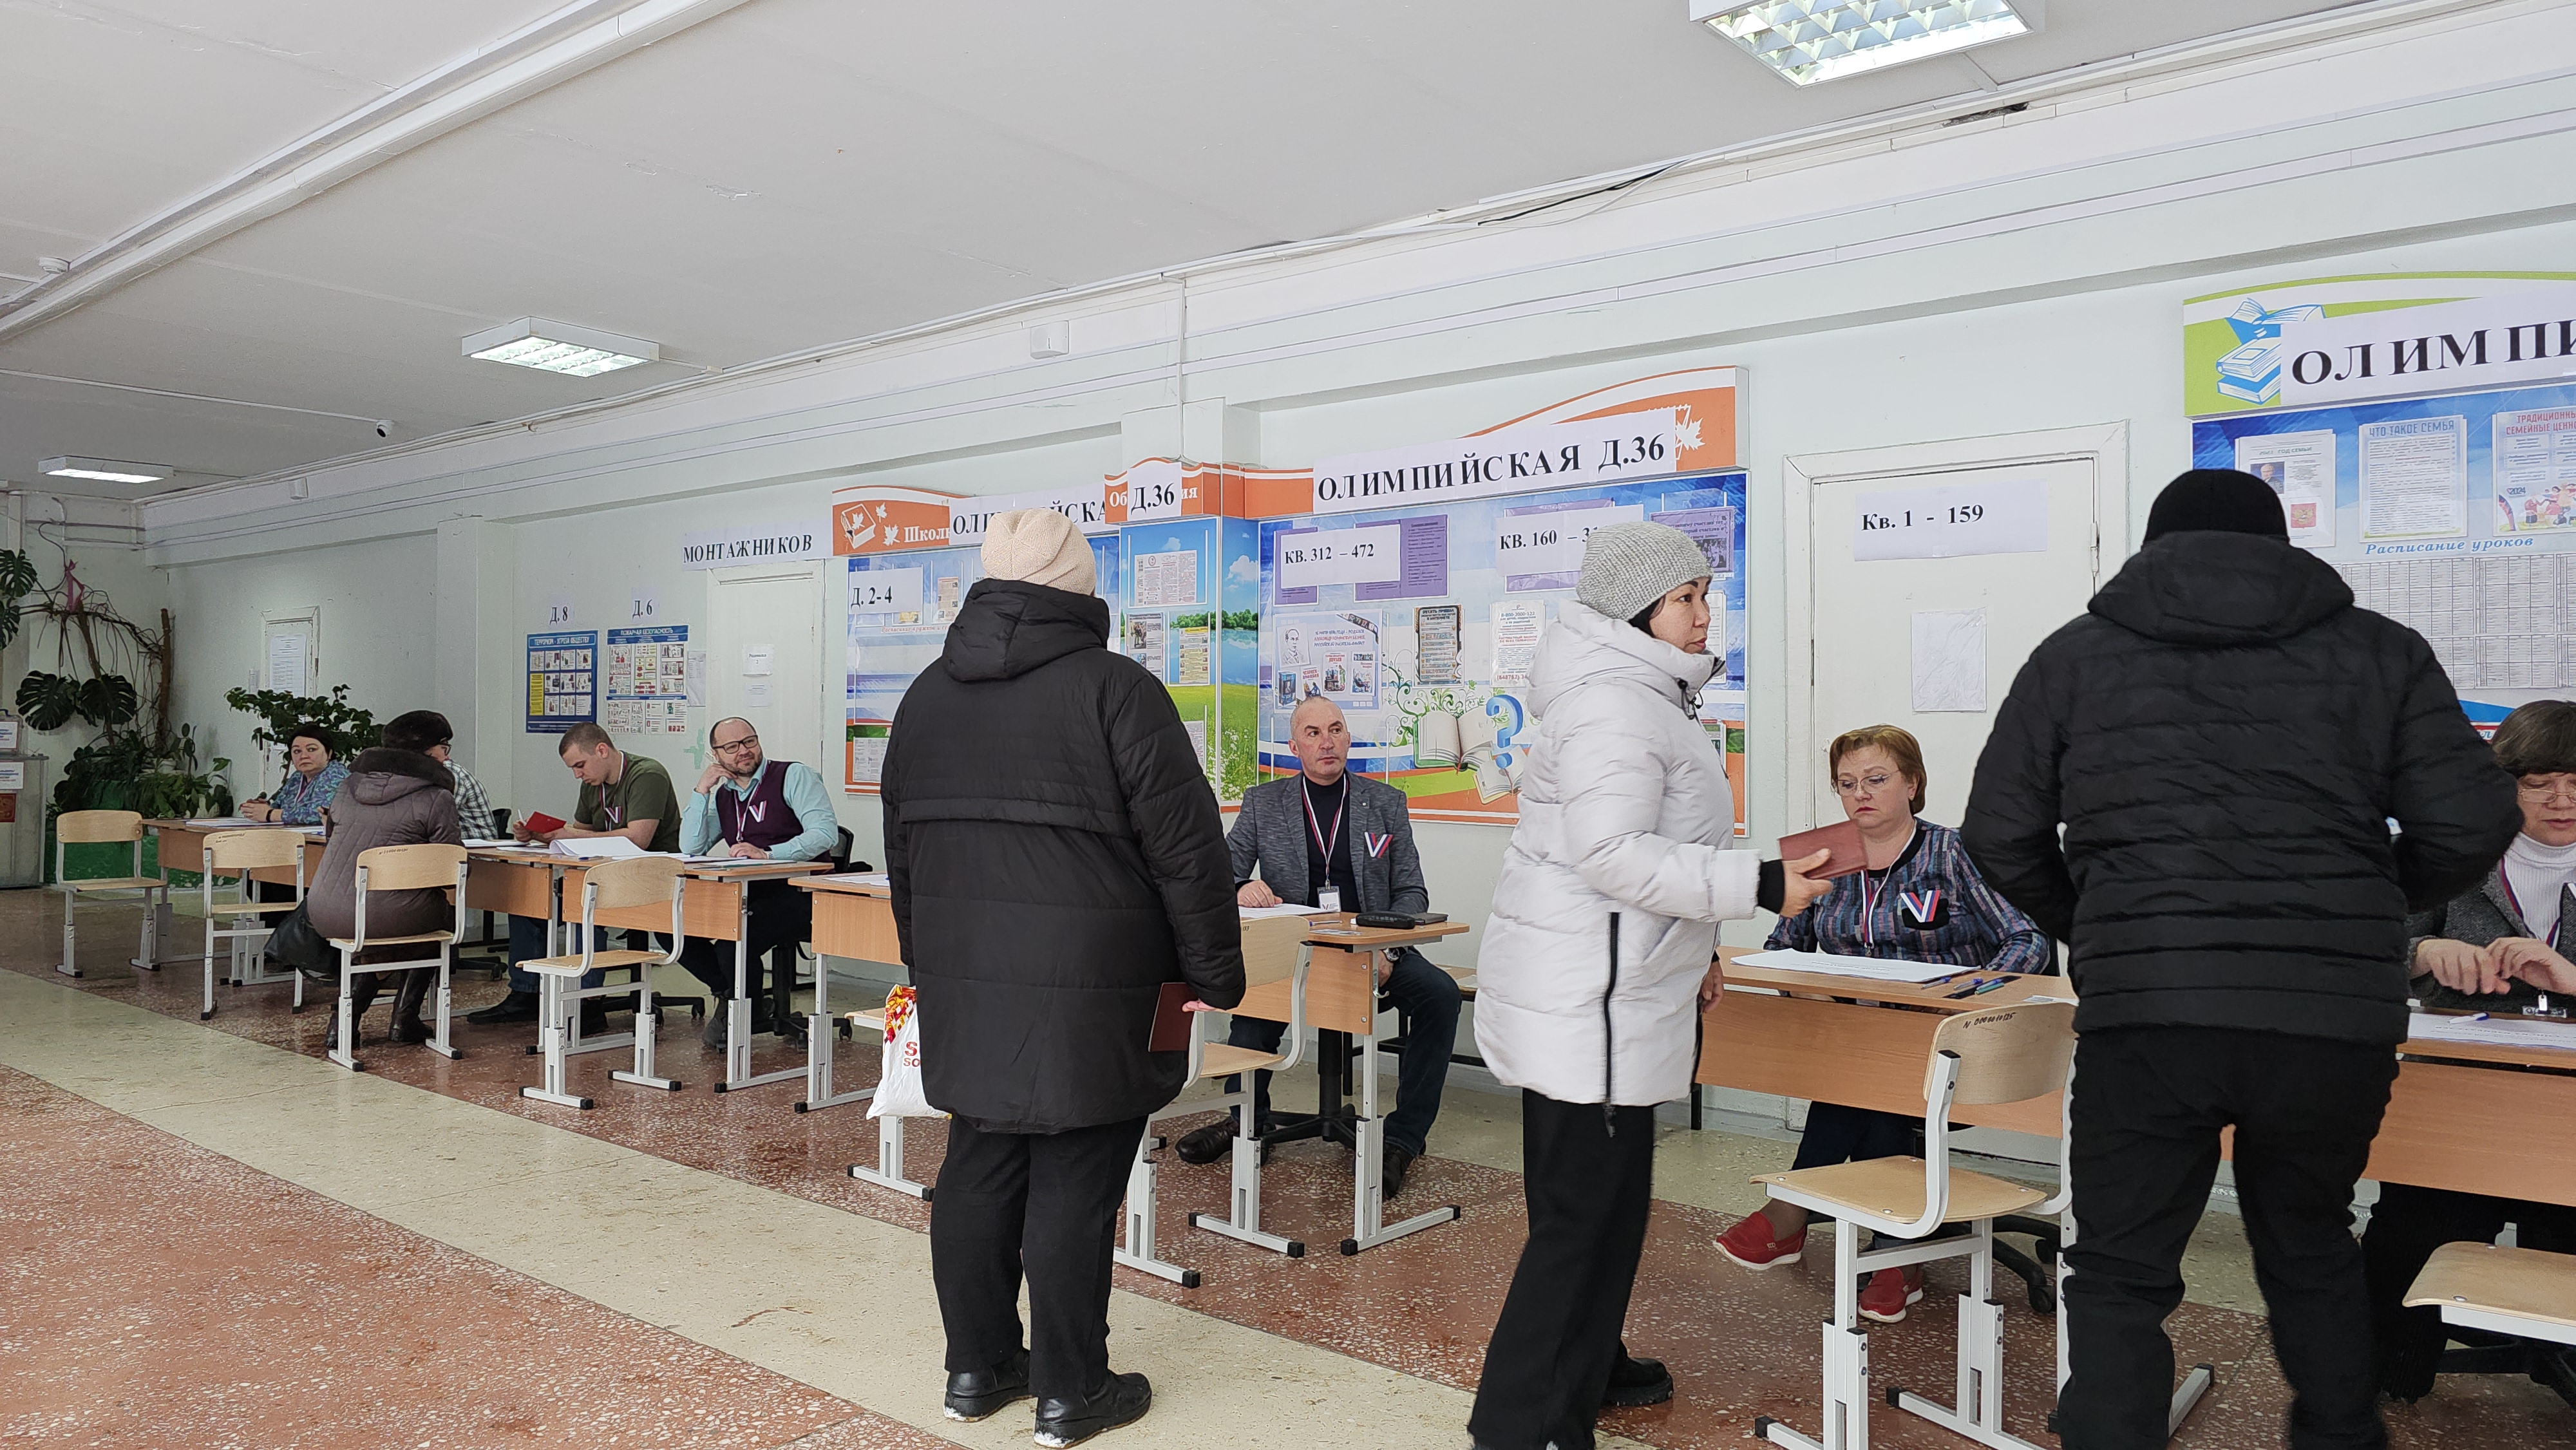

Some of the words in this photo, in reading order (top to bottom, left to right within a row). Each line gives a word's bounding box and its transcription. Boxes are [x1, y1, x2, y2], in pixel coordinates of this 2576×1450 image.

[2369, 427, 2385, 437] ЧТО
[2390, 424, 2418, 435] ТАКОЕ
[2421, 420, 2454, 433] СЕМЬЯ
[2506, 423, 2550, 435] СЕМЕЙНЫЕ
[1318, 444, 1582, 500] ОЛИМПИЙСКАЯ
[1598, 433, 1665, 474] Д.36
[1131, 482, 1175, 515] Д.36
[1861, 513, 1896, 531] Кв.
[1903, 511, 1913, 527] 1
[1947, 504, 1984, 525] 159
[683, 534, 812, 563] МОНТАЖНИКОВ
[1500, 534, 1526, 550] КВ.
[1532, 530, 1557, 546] 160
[2365, 540, 2465, 554] Расписание
[2470, 538, 2533, 552] уроков
[1284, 551, 1307, 564] КВ.
[1311, 547, 1332, 561] 312
[1351, 543, 1374, 558] 472
[851, 587, 864, 609] Д.
[549, 607, 560, 625] Д.
[562, 607, 568, 621] 8
[632, 600, 643, 619] Д.
[647, 599, 652, 615] 6
